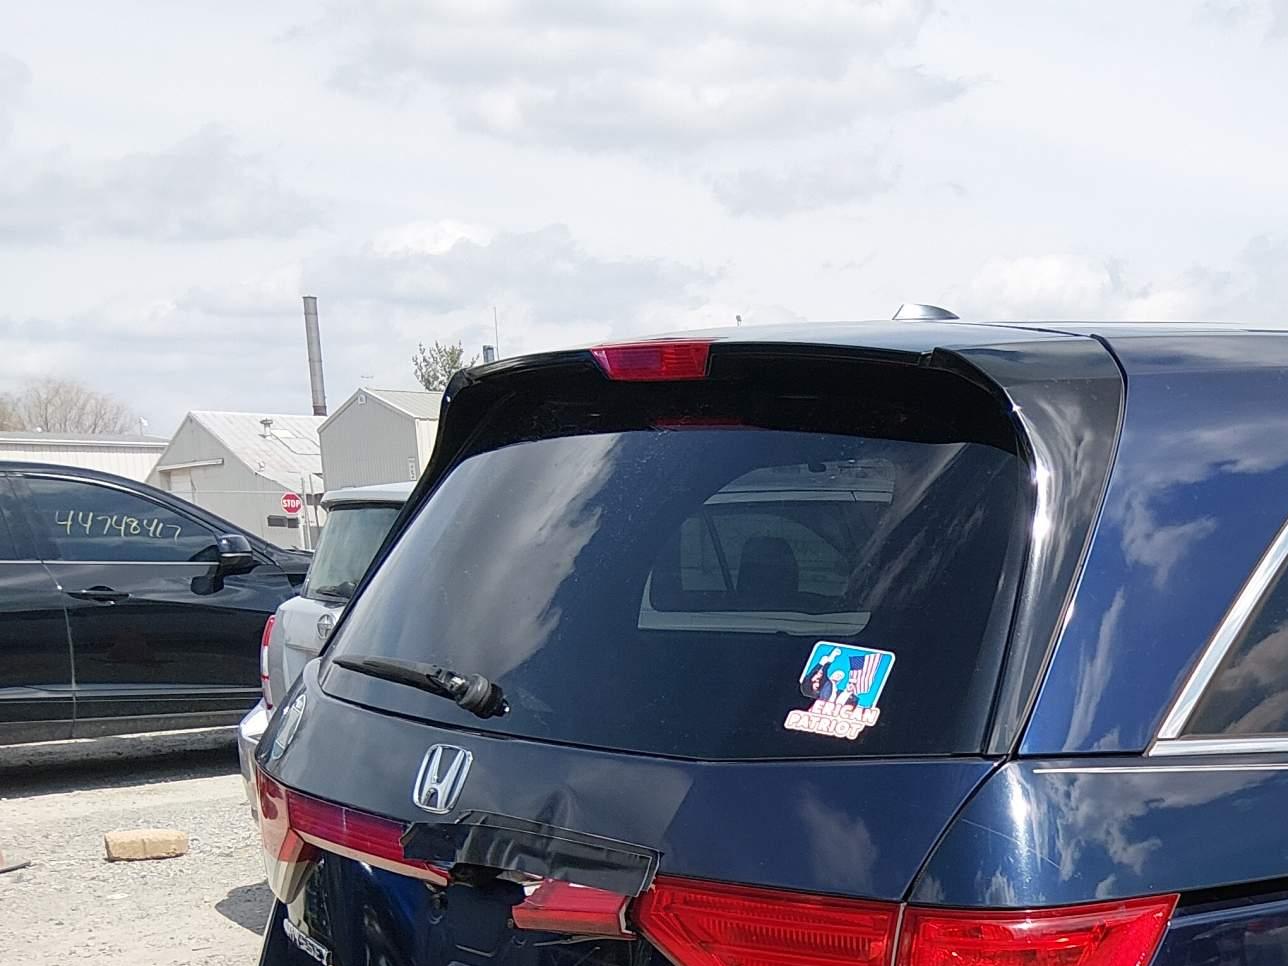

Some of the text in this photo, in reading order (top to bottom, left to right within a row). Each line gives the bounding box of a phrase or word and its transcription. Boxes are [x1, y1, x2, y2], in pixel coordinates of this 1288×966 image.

[282, 499, 301, 508] STOP
[55, 510, 182, 541] 44748417
[814, 699, 878, 723] ERICAN
[787, 712, 864, 738] PATRIOT
